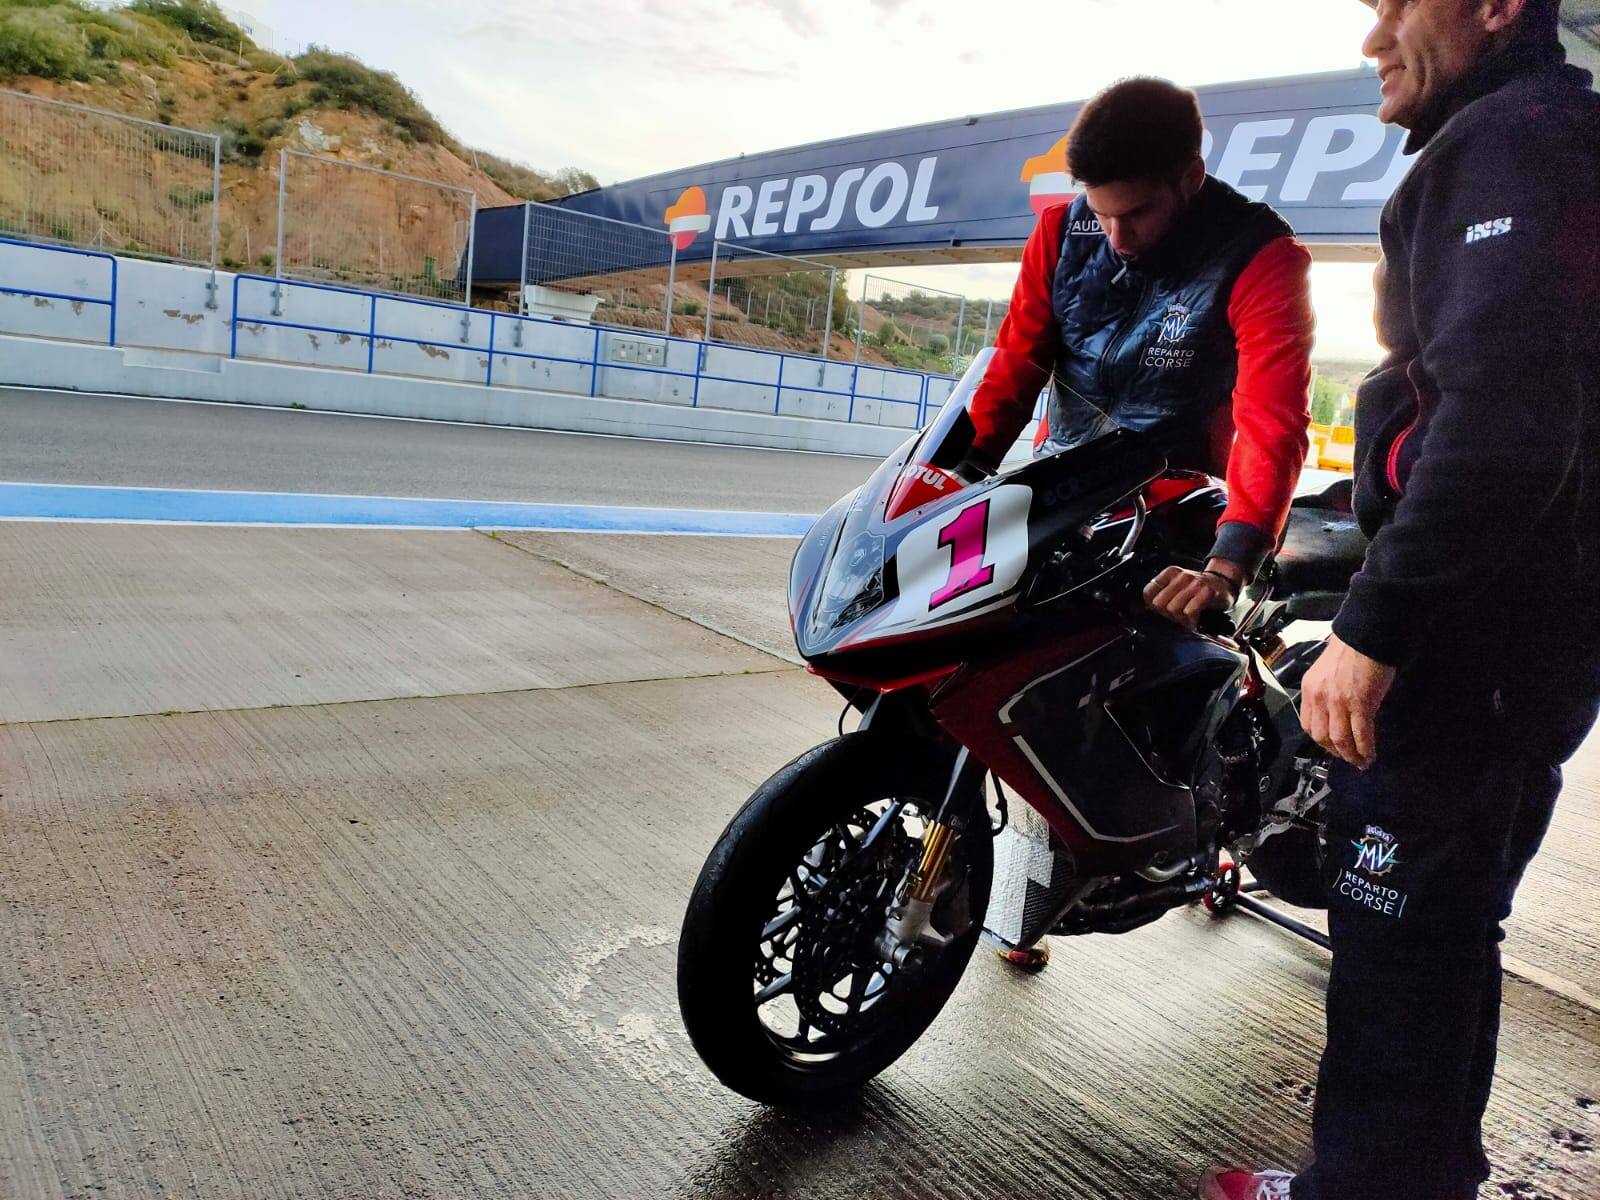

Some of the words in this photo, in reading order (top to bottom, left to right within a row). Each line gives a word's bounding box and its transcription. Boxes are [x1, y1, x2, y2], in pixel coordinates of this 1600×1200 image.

[1202, 114, 1421, 201] EPS
[715, 157, 938, 239] REPSOL
[1157, 314, 1191, 342] MV
[1145, 356, 1192, 368] CORSE
[1147, 347, 1195, 358] REPARTO
[928, 498, 995, 612] 1
[1354, 843, 1399, 870] MV
[1340, 882, 1395, 914] CORSE
[1345, 870, 1398, 900] REPARTO
